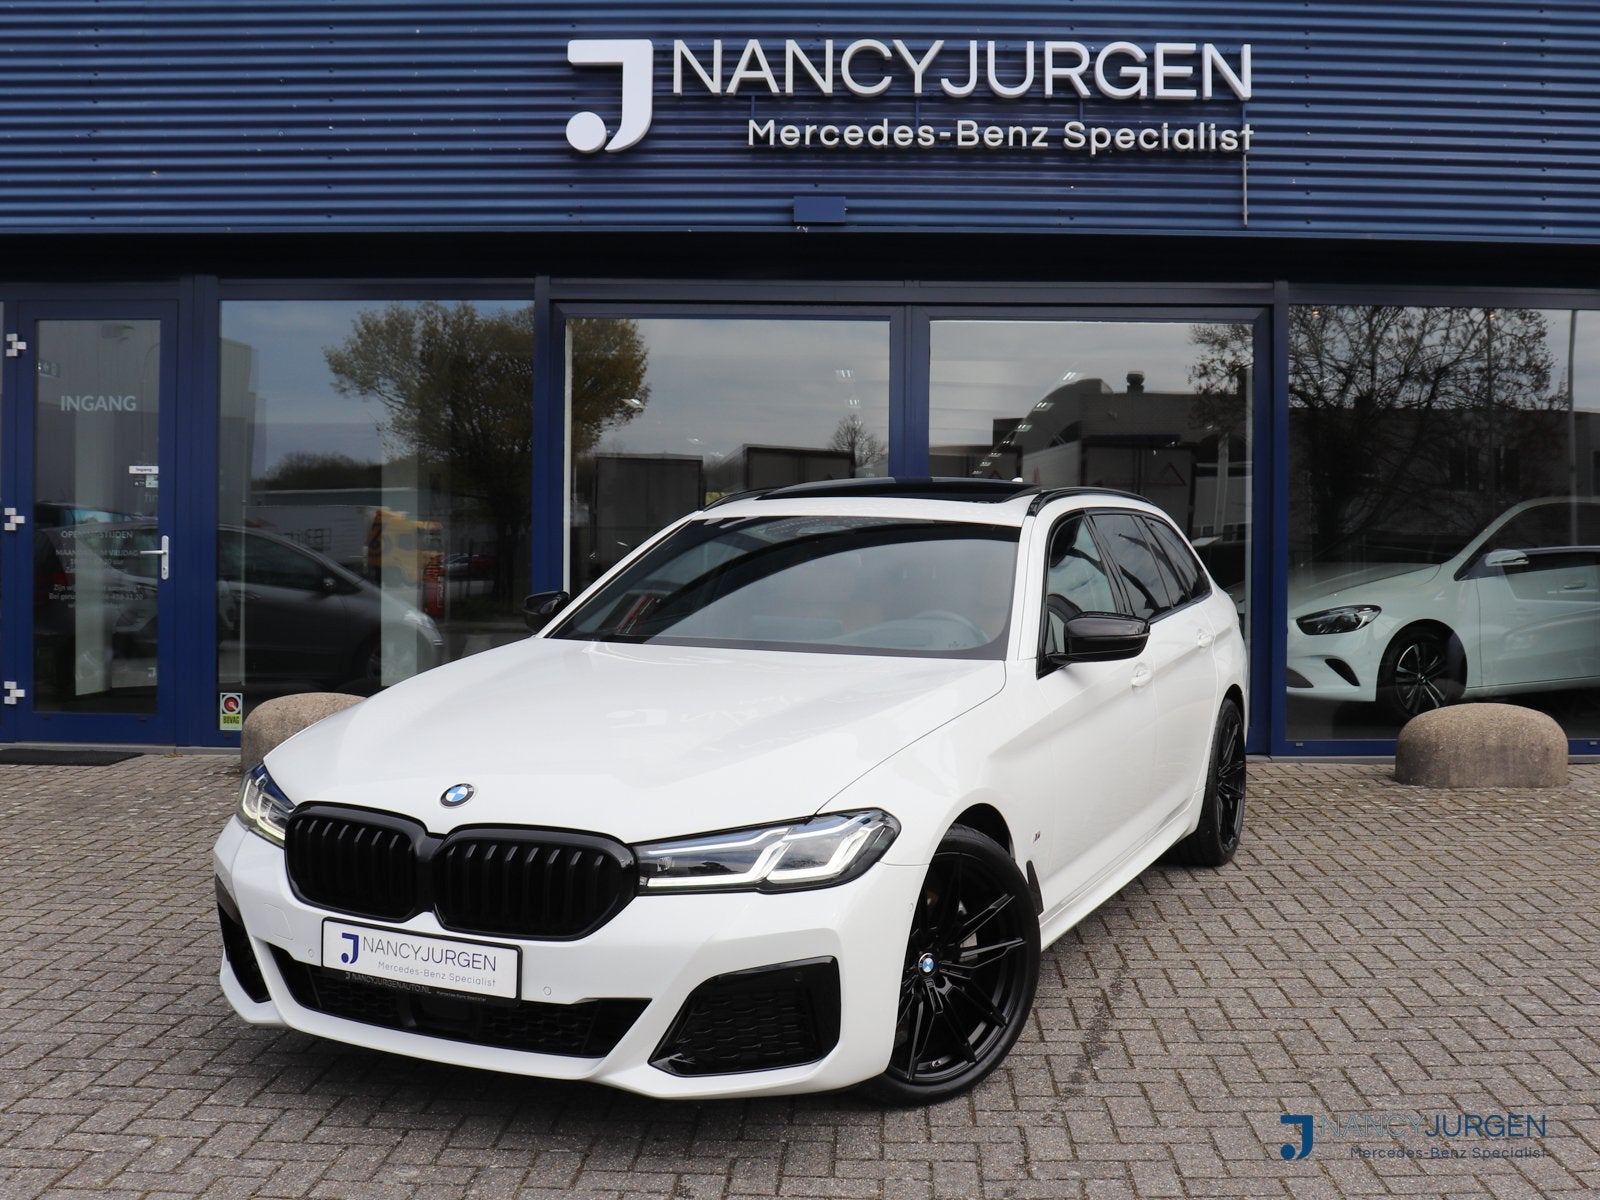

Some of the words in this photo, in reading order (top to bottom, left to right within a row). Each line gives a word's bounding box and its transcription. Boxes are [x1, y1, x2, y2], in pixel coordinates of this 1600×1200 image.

[672, 39, 1252, 101] NANCYJURGEN
[747, 118, 1049, 148] Mercedes-Benz
[1062, 121, 1254, 155] Specialist
[60, 395, 137, 412] INGANG
[363, 936, 496, 972] NANCYJURGEN
[377, 962, 446, 980] Mercedes-Benz
[449, 973, 496, 987] Specialist
